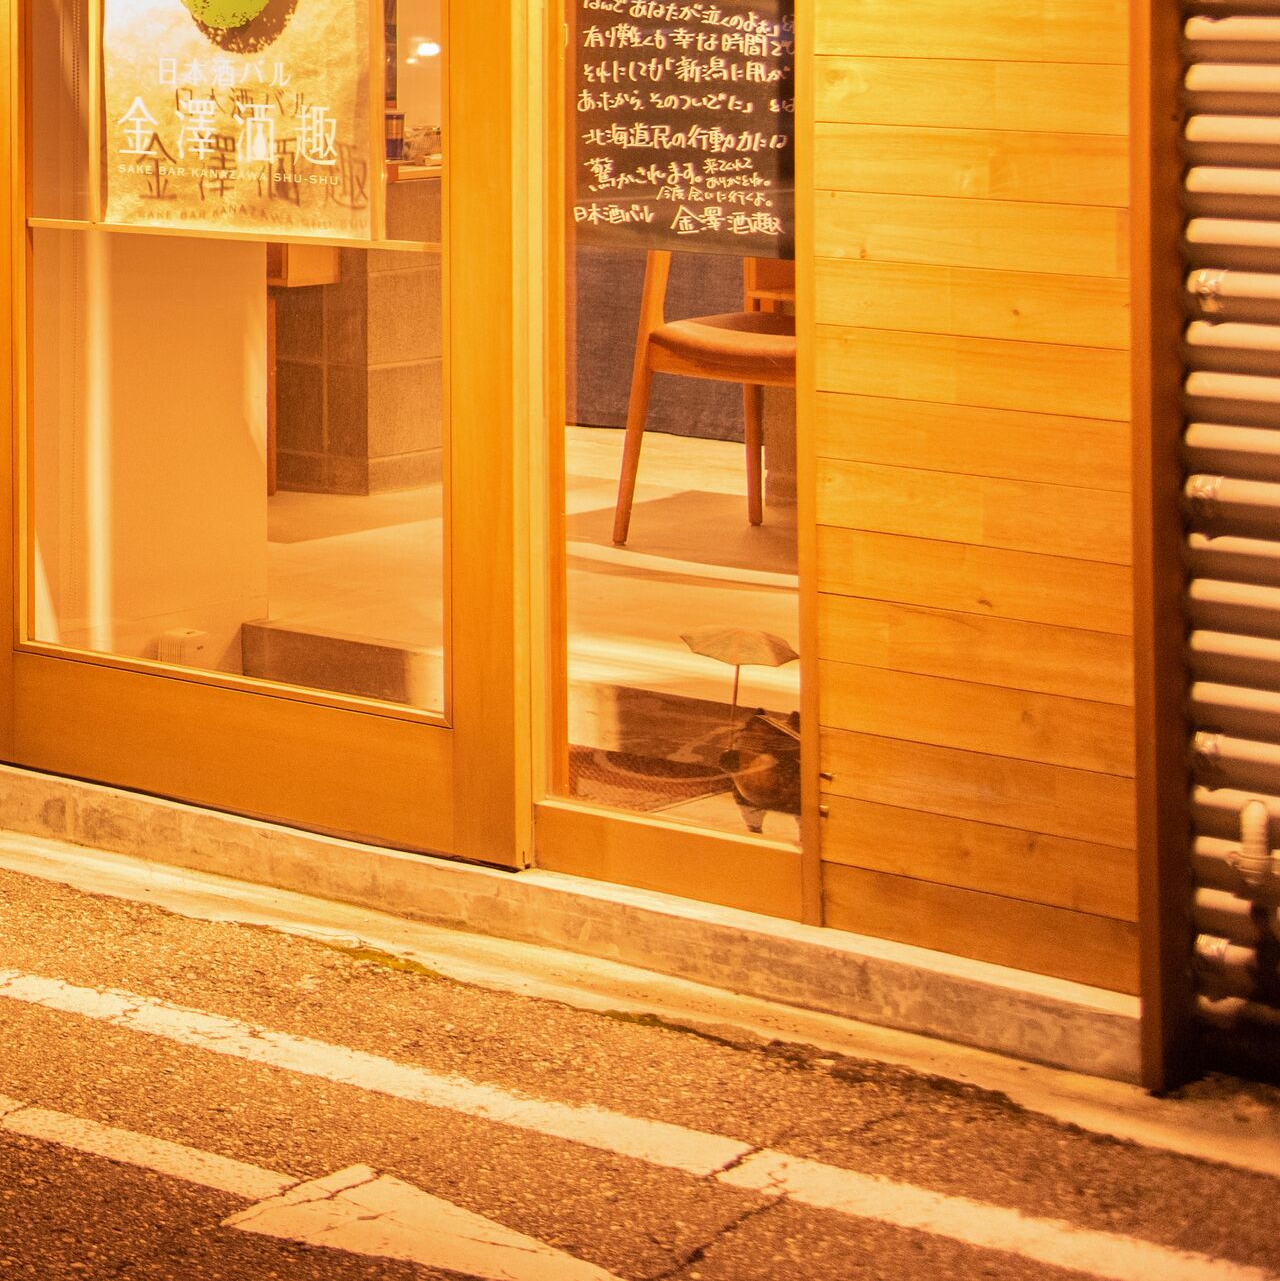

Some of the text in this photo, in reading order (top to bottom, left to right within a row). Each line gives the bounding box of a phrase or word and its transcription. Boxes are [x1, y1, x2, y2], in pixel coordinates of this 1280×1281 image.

[159, 57, 292, 88] 日本酒バル
[117, 96, 338, 166] 金澤酒趣
[118, 164, 152, 175] SAKE
[158, 166, 185, 177] BAR
[273, 173, 339, 185] SHU-SHU
